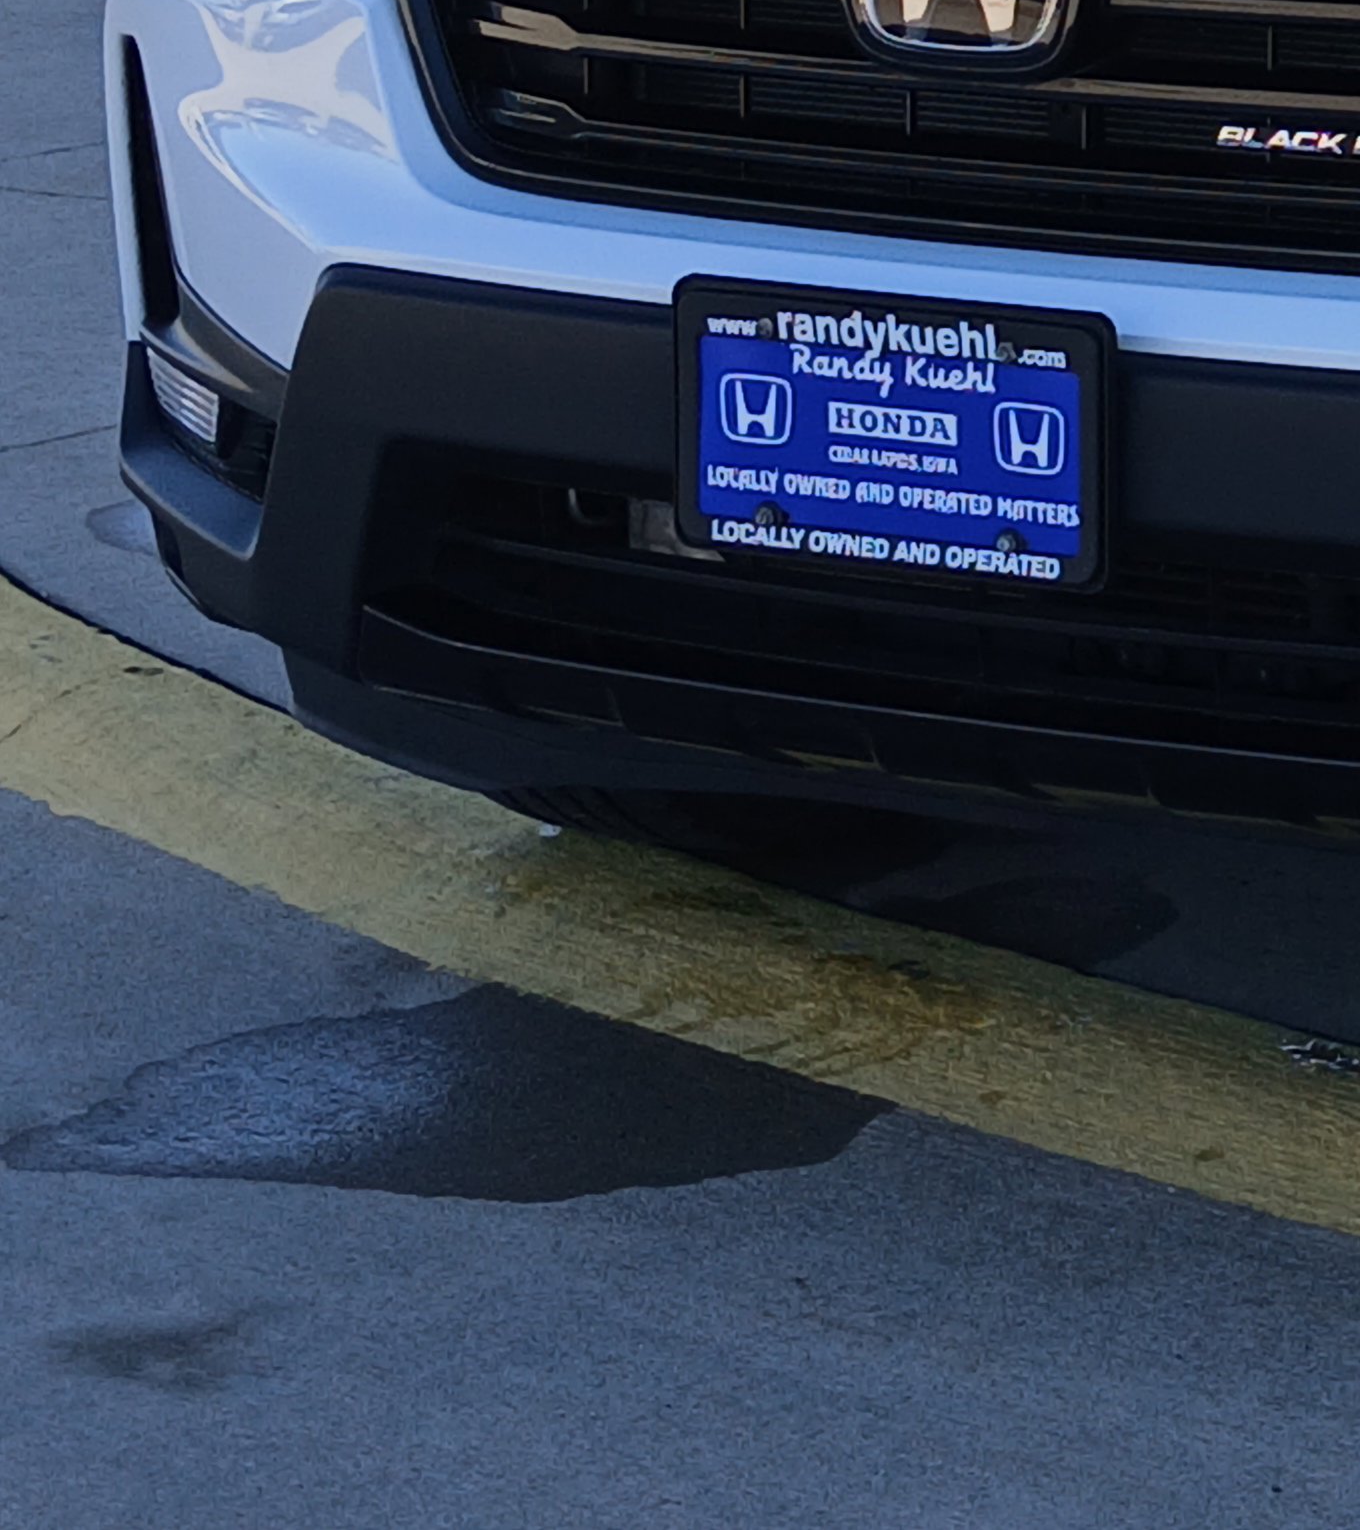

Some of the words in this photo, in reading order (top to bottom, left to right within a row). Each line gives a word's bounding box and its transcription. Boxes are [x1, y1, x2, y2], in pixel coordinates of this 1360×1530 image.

[1217, 126, 1347, 155] BLACK
[776, 310, 999, 361] randykuehl
[789, 343, 894, 399] Randy
[905, 356, 996, 395] Kuehl
[835, 407, 952, 440] HONDA
[707, 464, 779, 494] LOCALLY
[783, 473, 850, 500] OWNED
[855, 481, 894, 505] AND
[899, 485, 992, 516] OPERATED
[997, 496, 1080, 527] MATTERS
[711, 519, 805, 550] LOCALLY
[808, 530, 890, 560] OWNED
[893, 540, 941, 566] AND
[945, 545, 1060, 579] OPERATED
